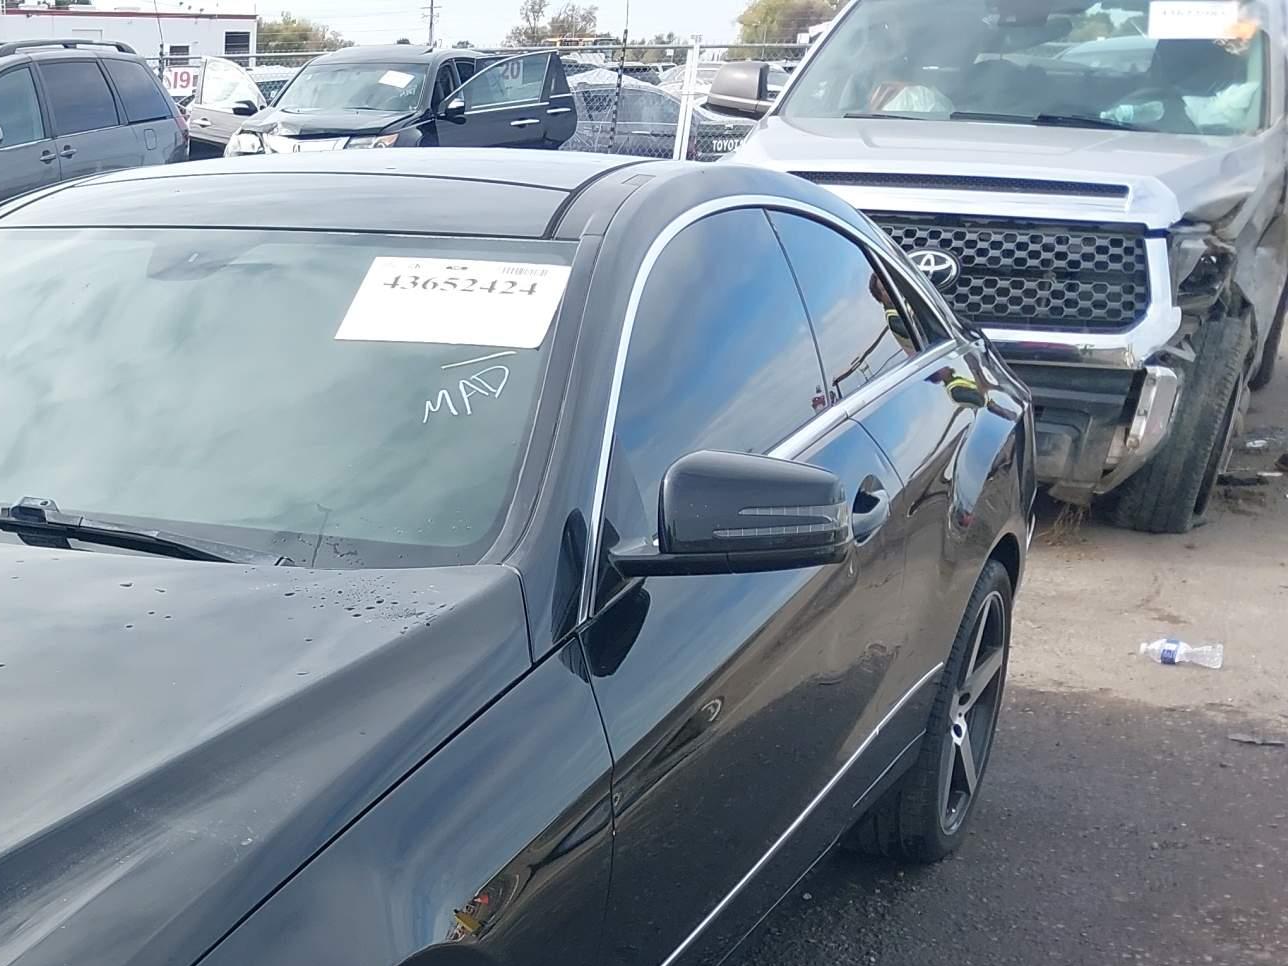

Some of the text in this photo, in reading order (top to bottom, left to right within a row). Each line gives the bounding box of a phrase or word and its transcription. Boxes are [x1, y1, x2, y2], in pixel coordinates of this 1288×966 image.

[173, 71, 191, 89] 19
[502, 61, 520, 80] 20
[383, 275, 538, 296] 43652424
[422, 365, 510, 423] MAD
